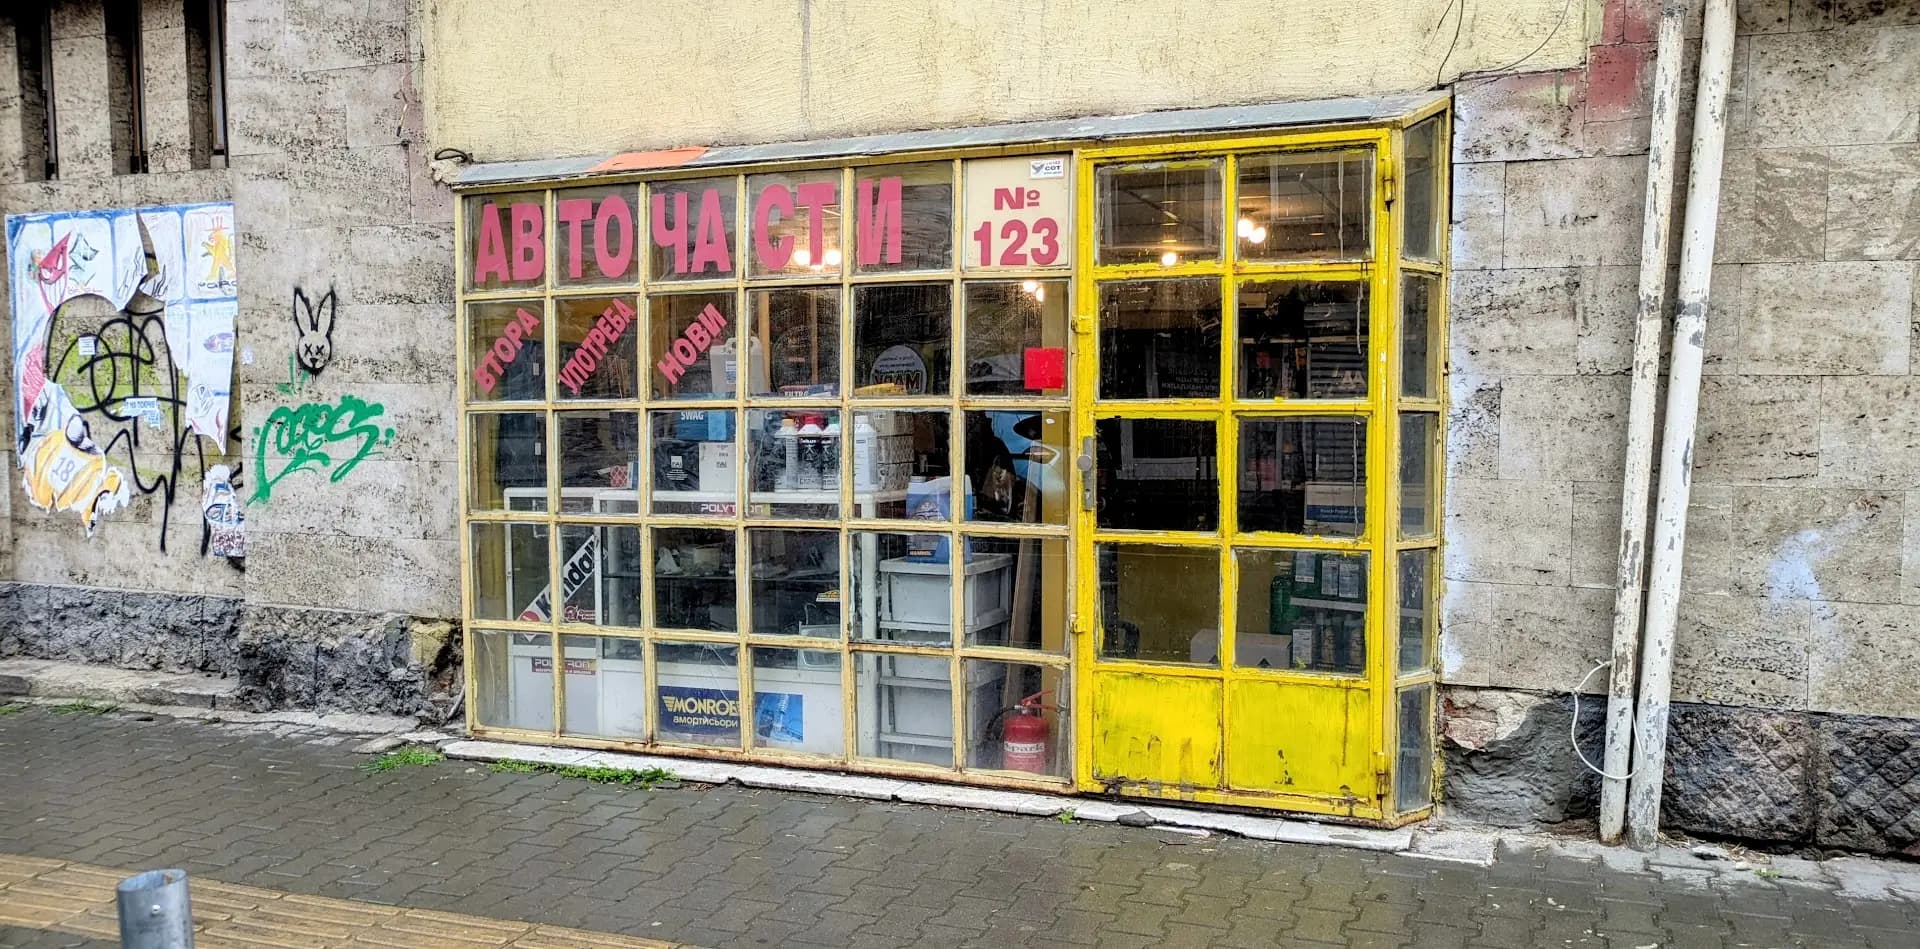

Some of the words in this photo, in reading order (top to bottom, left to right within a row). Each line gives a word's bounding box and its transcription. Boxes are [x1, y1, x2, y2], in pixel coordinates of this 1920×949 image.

[974, 217, 1060, 267] 123
[473, 307, 540, 393] ВТОРА
[558, 298, 637, 395] УПОТРЕБА
[656, 302, 728, 385] НОВИ
[680, 411, 704, 421] SWAG
[51, 456, 76, 482] 18
[700, 503, 763, 513] POLYTON
[534, 658, 589, 669] POLRON
[673, 696, 740, 716] MONROE
[672, 715, 738, 728] амортисьори
